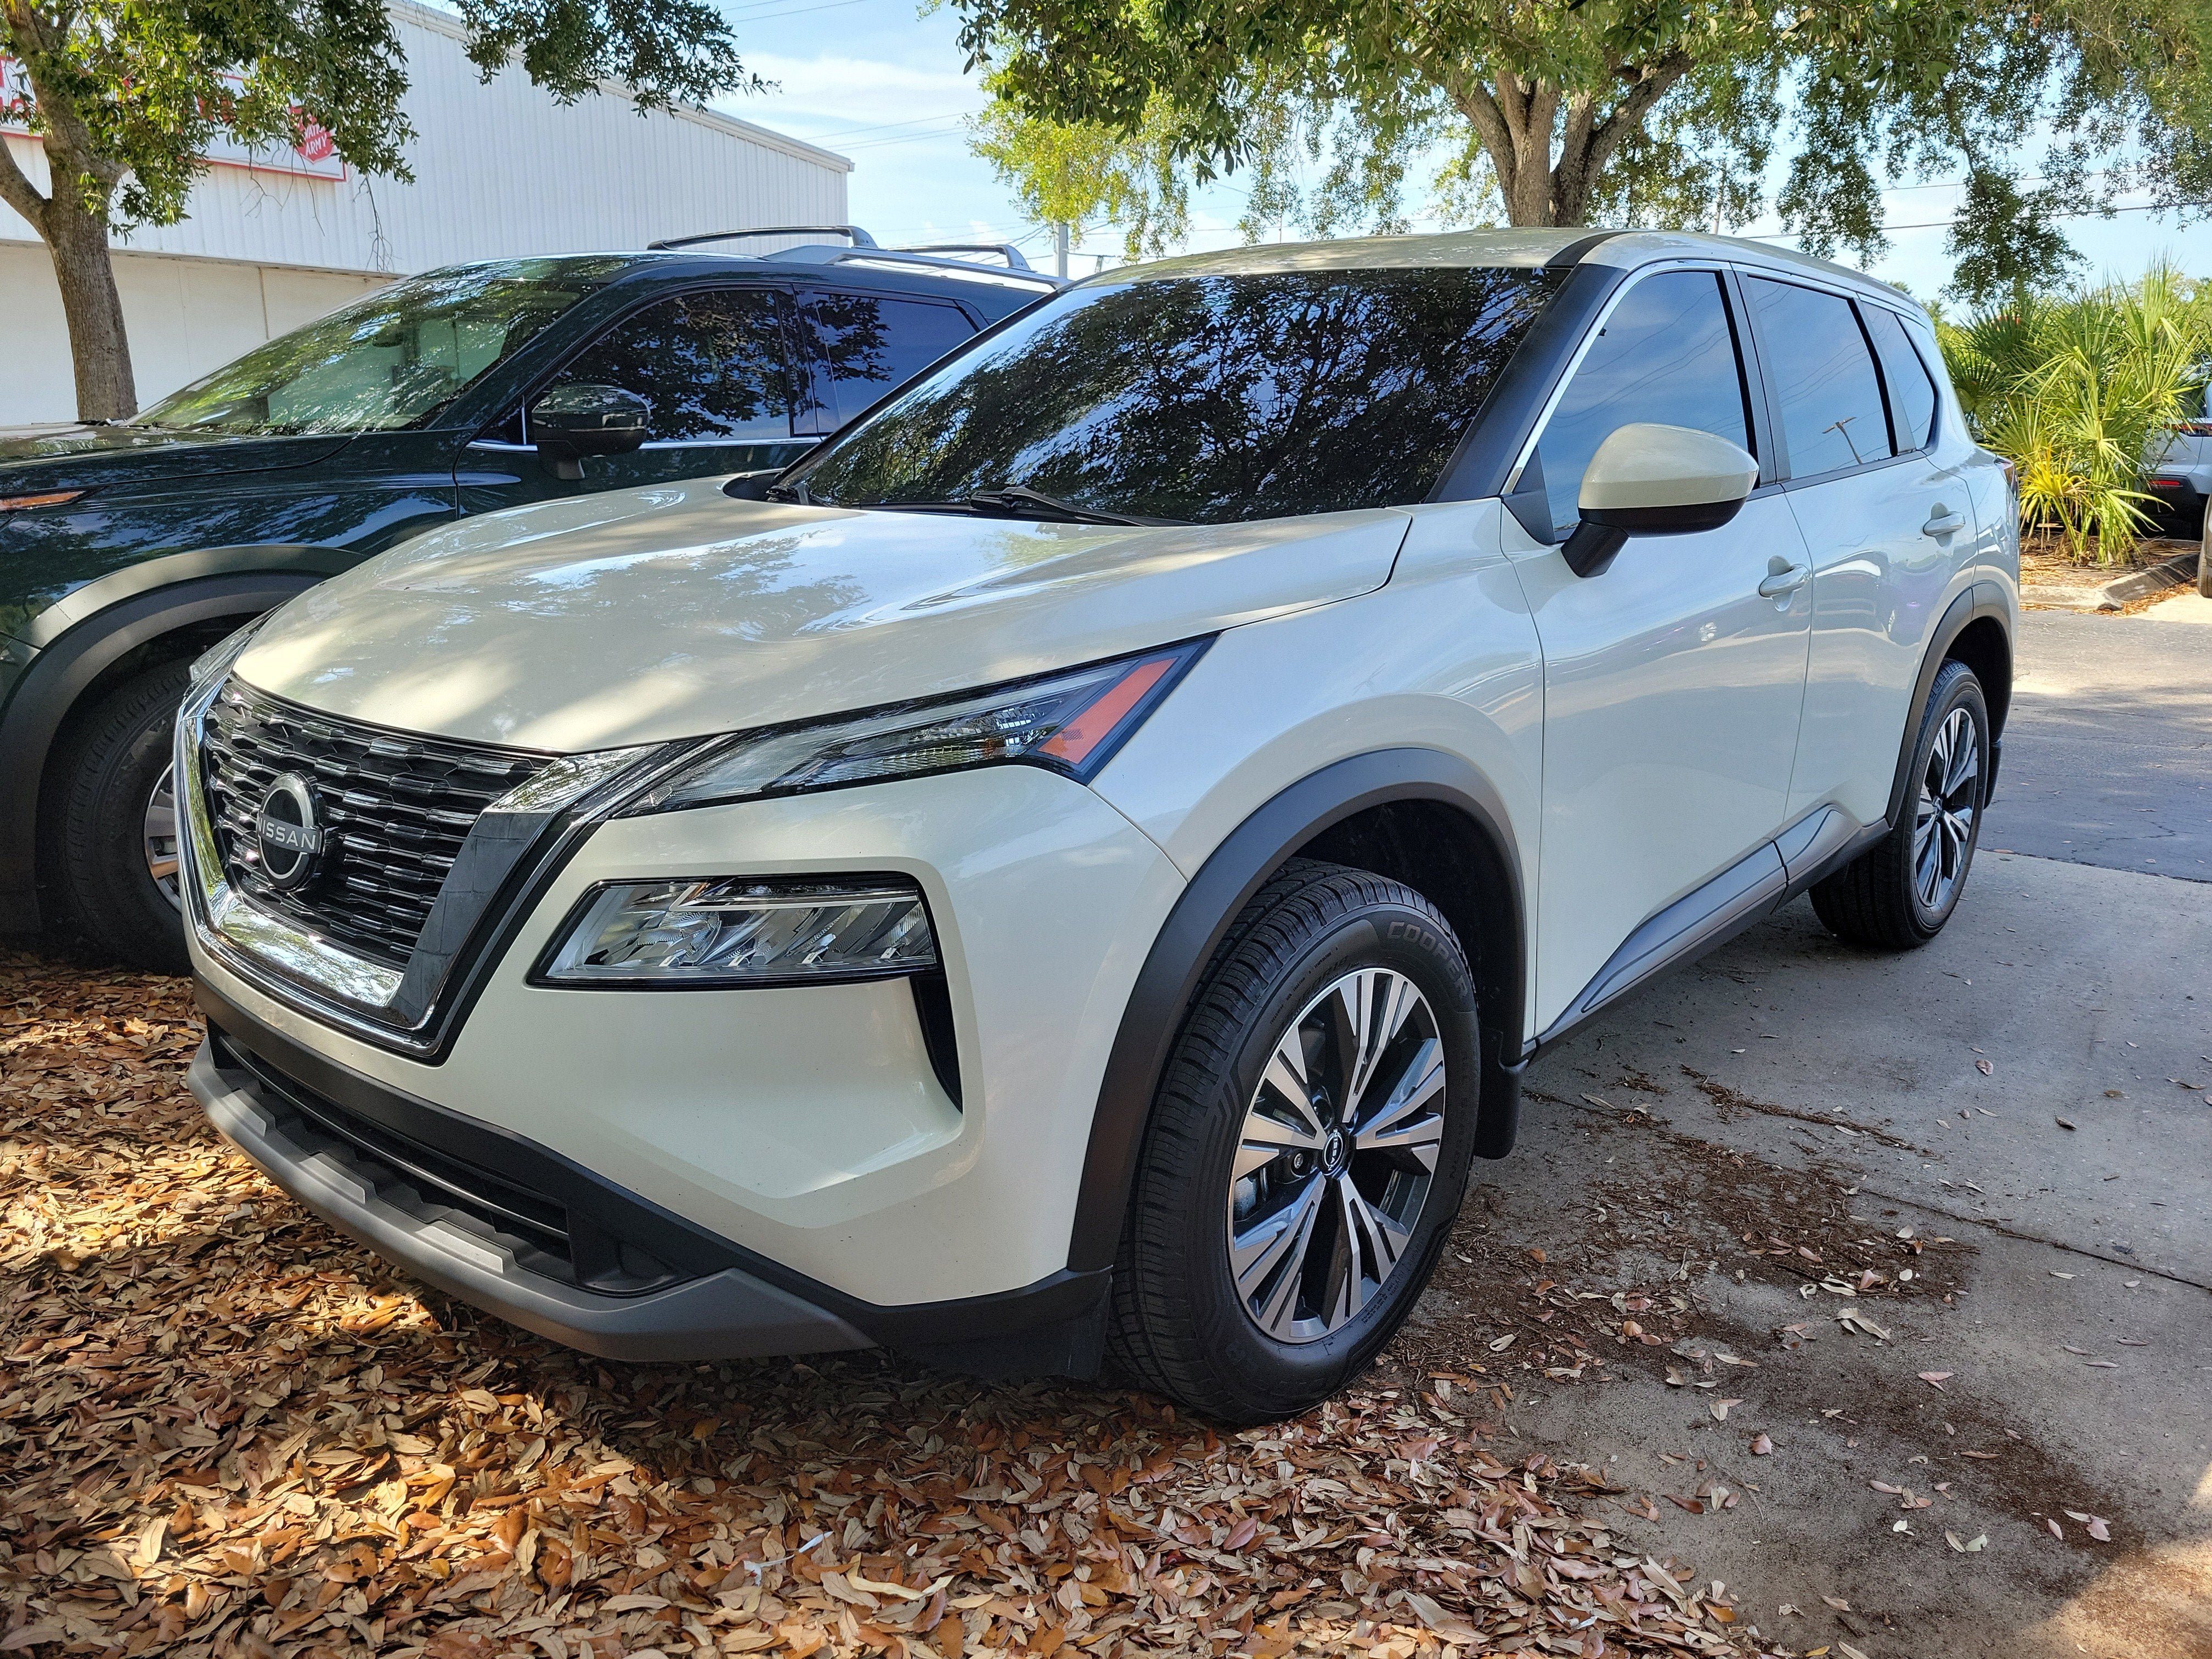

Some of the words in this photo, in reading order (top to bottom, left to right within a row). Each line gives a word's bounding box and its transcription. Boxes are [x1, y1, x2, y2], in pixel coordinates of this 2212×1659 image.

[305, 132, 328, 156] ARMY
[256, 816, 317, 850] NISSAN
[1387, 921, 1469, 998] COOPER
[1328, 1129, 1338, 1171] NISSAN
